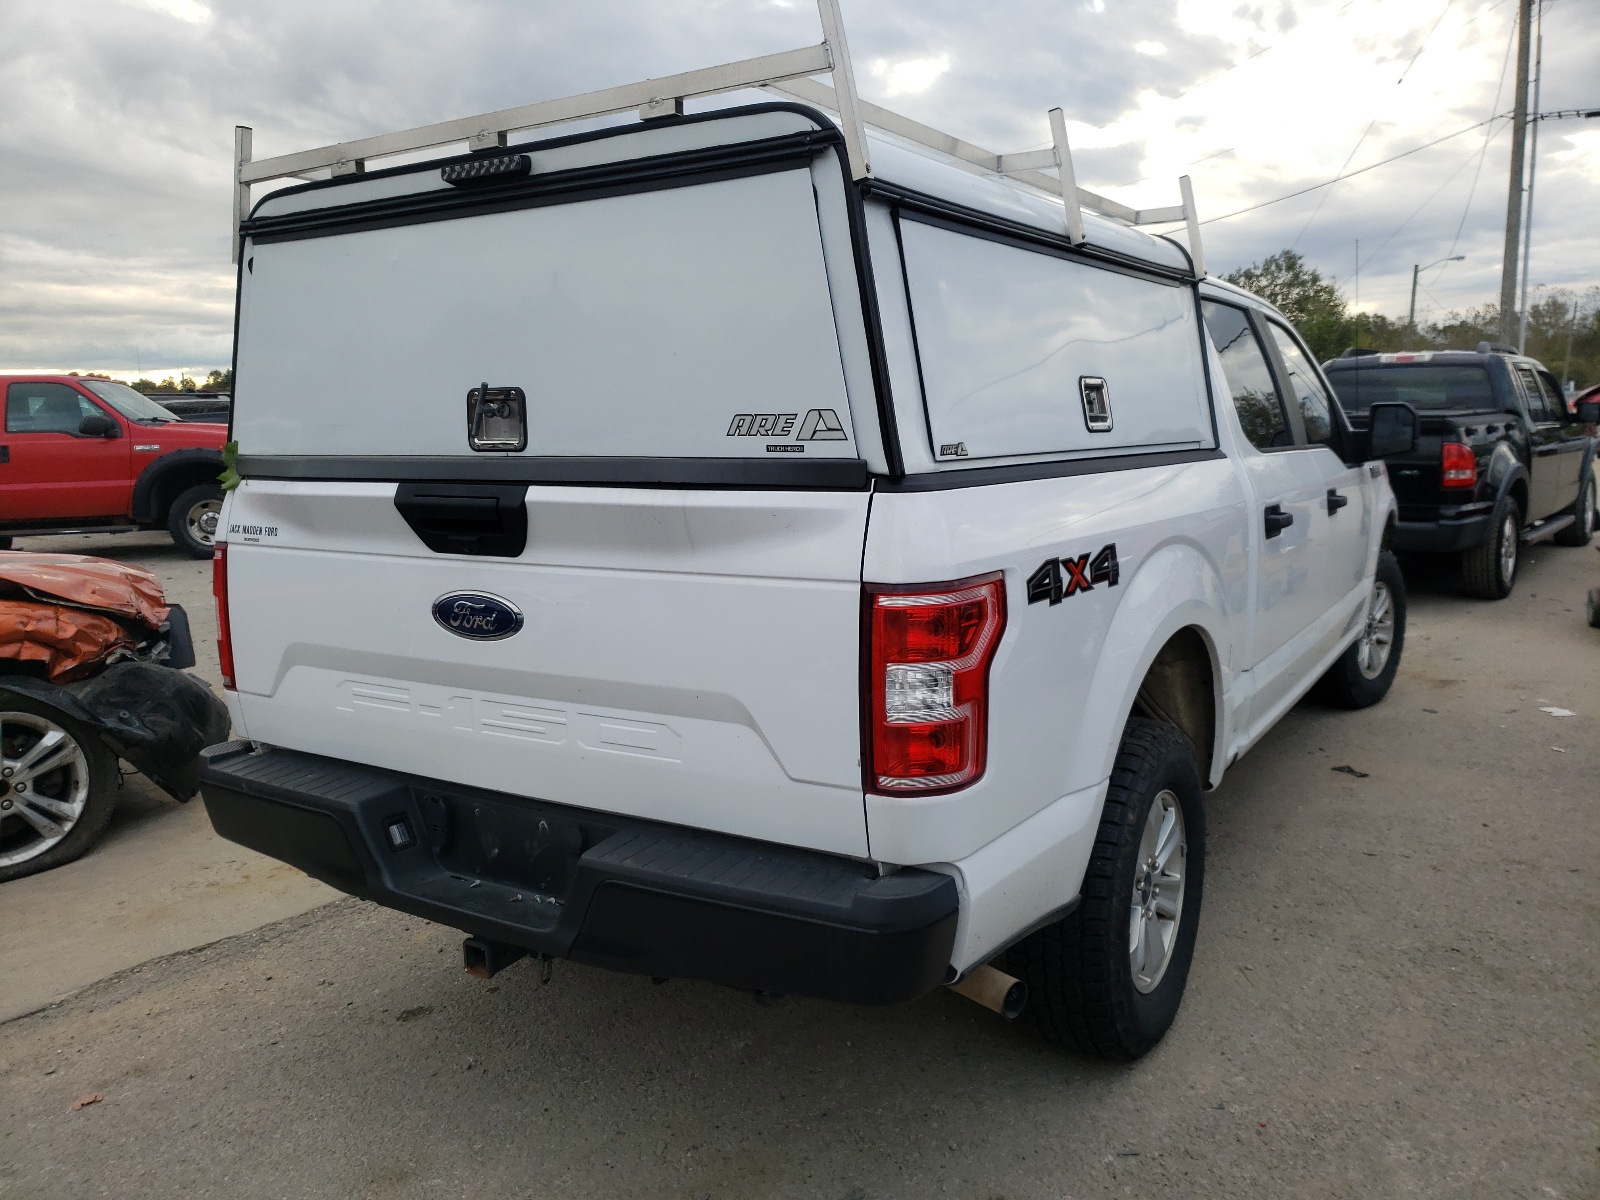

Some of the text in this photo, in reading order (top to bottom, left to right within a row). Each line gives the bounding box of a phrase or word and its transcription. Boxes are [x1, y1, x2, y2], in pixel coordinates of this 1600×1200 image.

[726, 413, 798, 437] ARE
[229, 524, 278, 537] JACK MADDEN FORD
[449, 600, 498, 630] Ford
[336, 679, 682, 764] F-150
